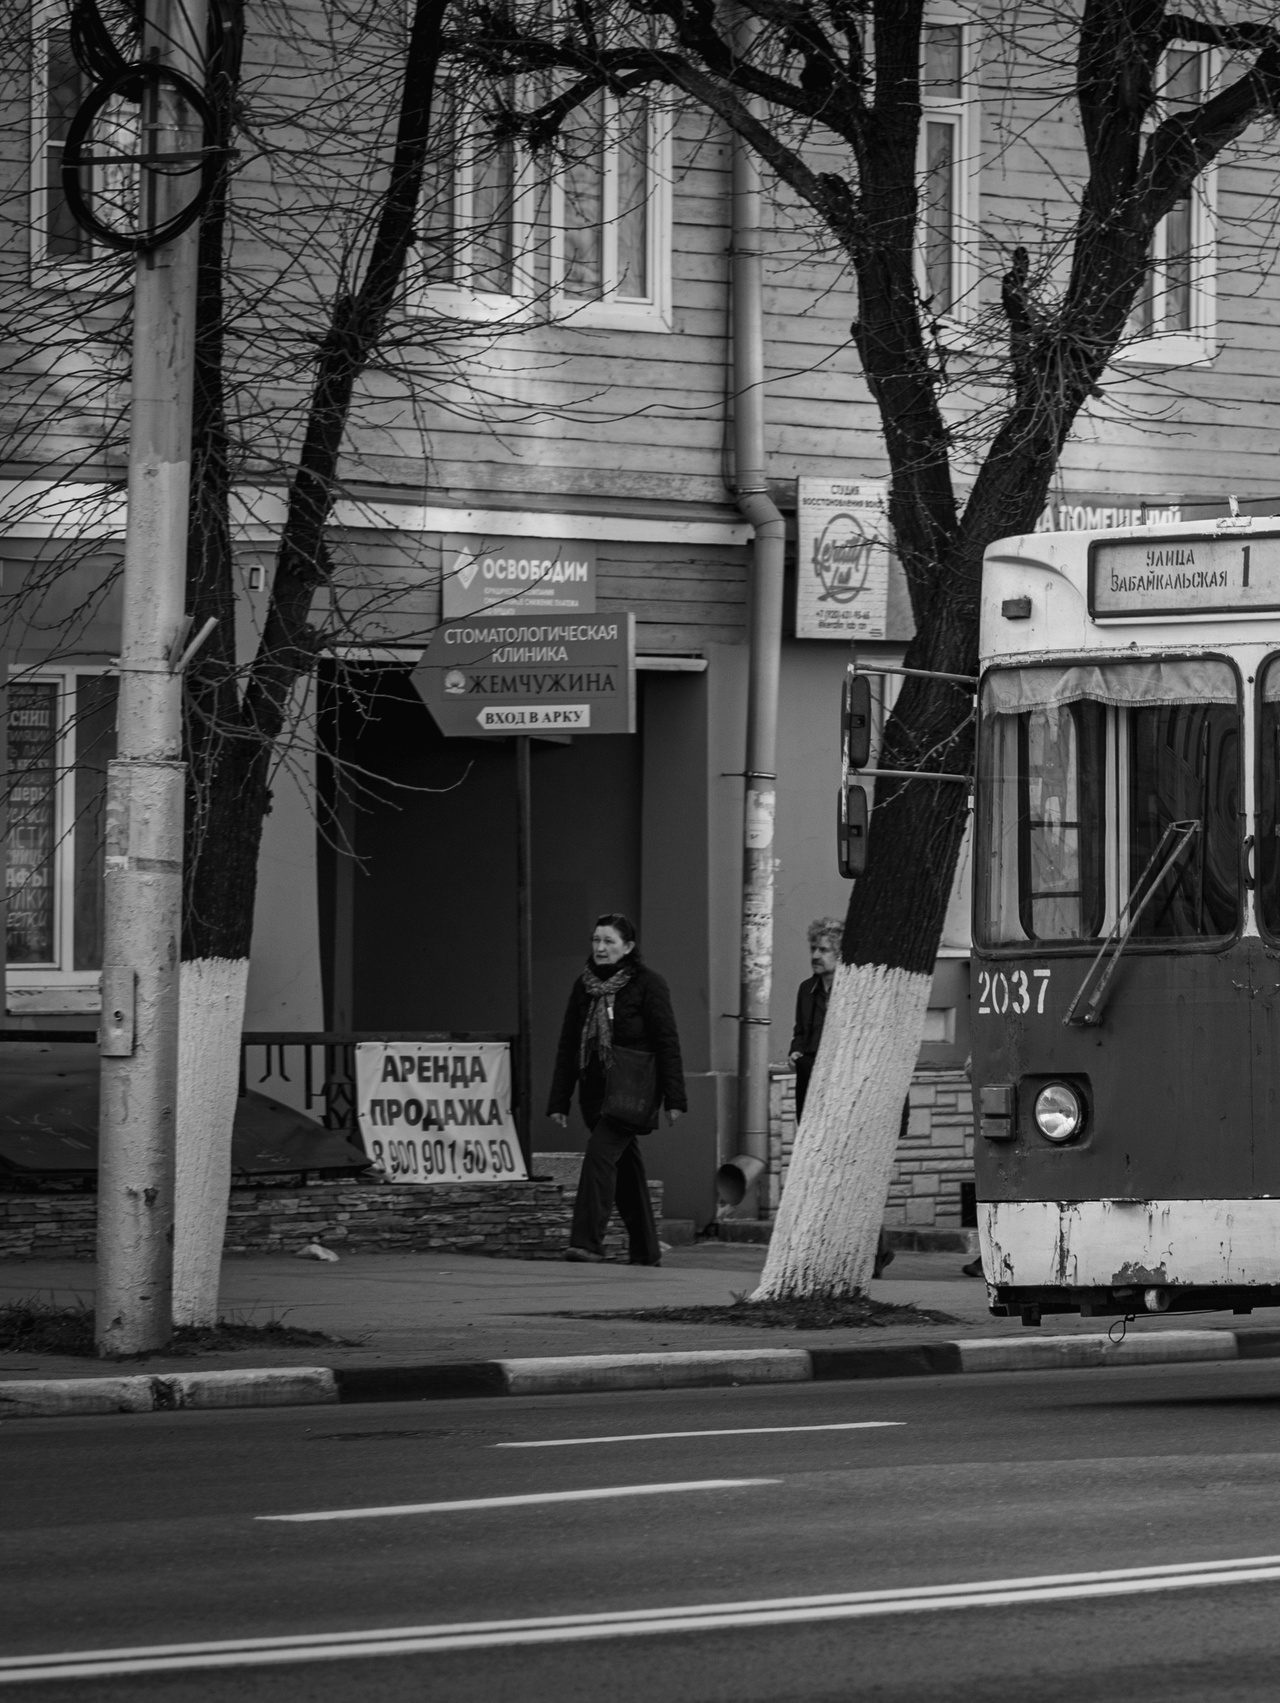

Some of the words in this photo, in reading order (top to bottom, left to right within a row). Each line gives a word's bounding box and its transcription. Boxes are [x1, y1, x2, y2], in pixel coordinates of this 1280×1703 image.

[482, 557, 588, 583] ОСВОБОДИМ
[1146, 548, 1196, 567] УЛИЦА
[1240, 544, 1252, 588] 1
[1110, 568, 1228, 593] ЗАБАЙКАЛЬСКАЯ
[443, 624, 618, 645] СТОМАТОЛОГИЧЕСКАЯ
[492, 646, 569, 664] КЛИНИКА
[467, 673, 615, 695] ЖЕМЧУЖИНА
[485, 711, 527, 725] ВХОД
[529, 711, 539, 724] В
[542, 709, 584, 724] АРКУ
[978, 969, 1051, 1015] 2037
[381, 1055, 488, 1089] АРЕНДА
[370, 1098, 503, 1132] ПРОДАЖА
